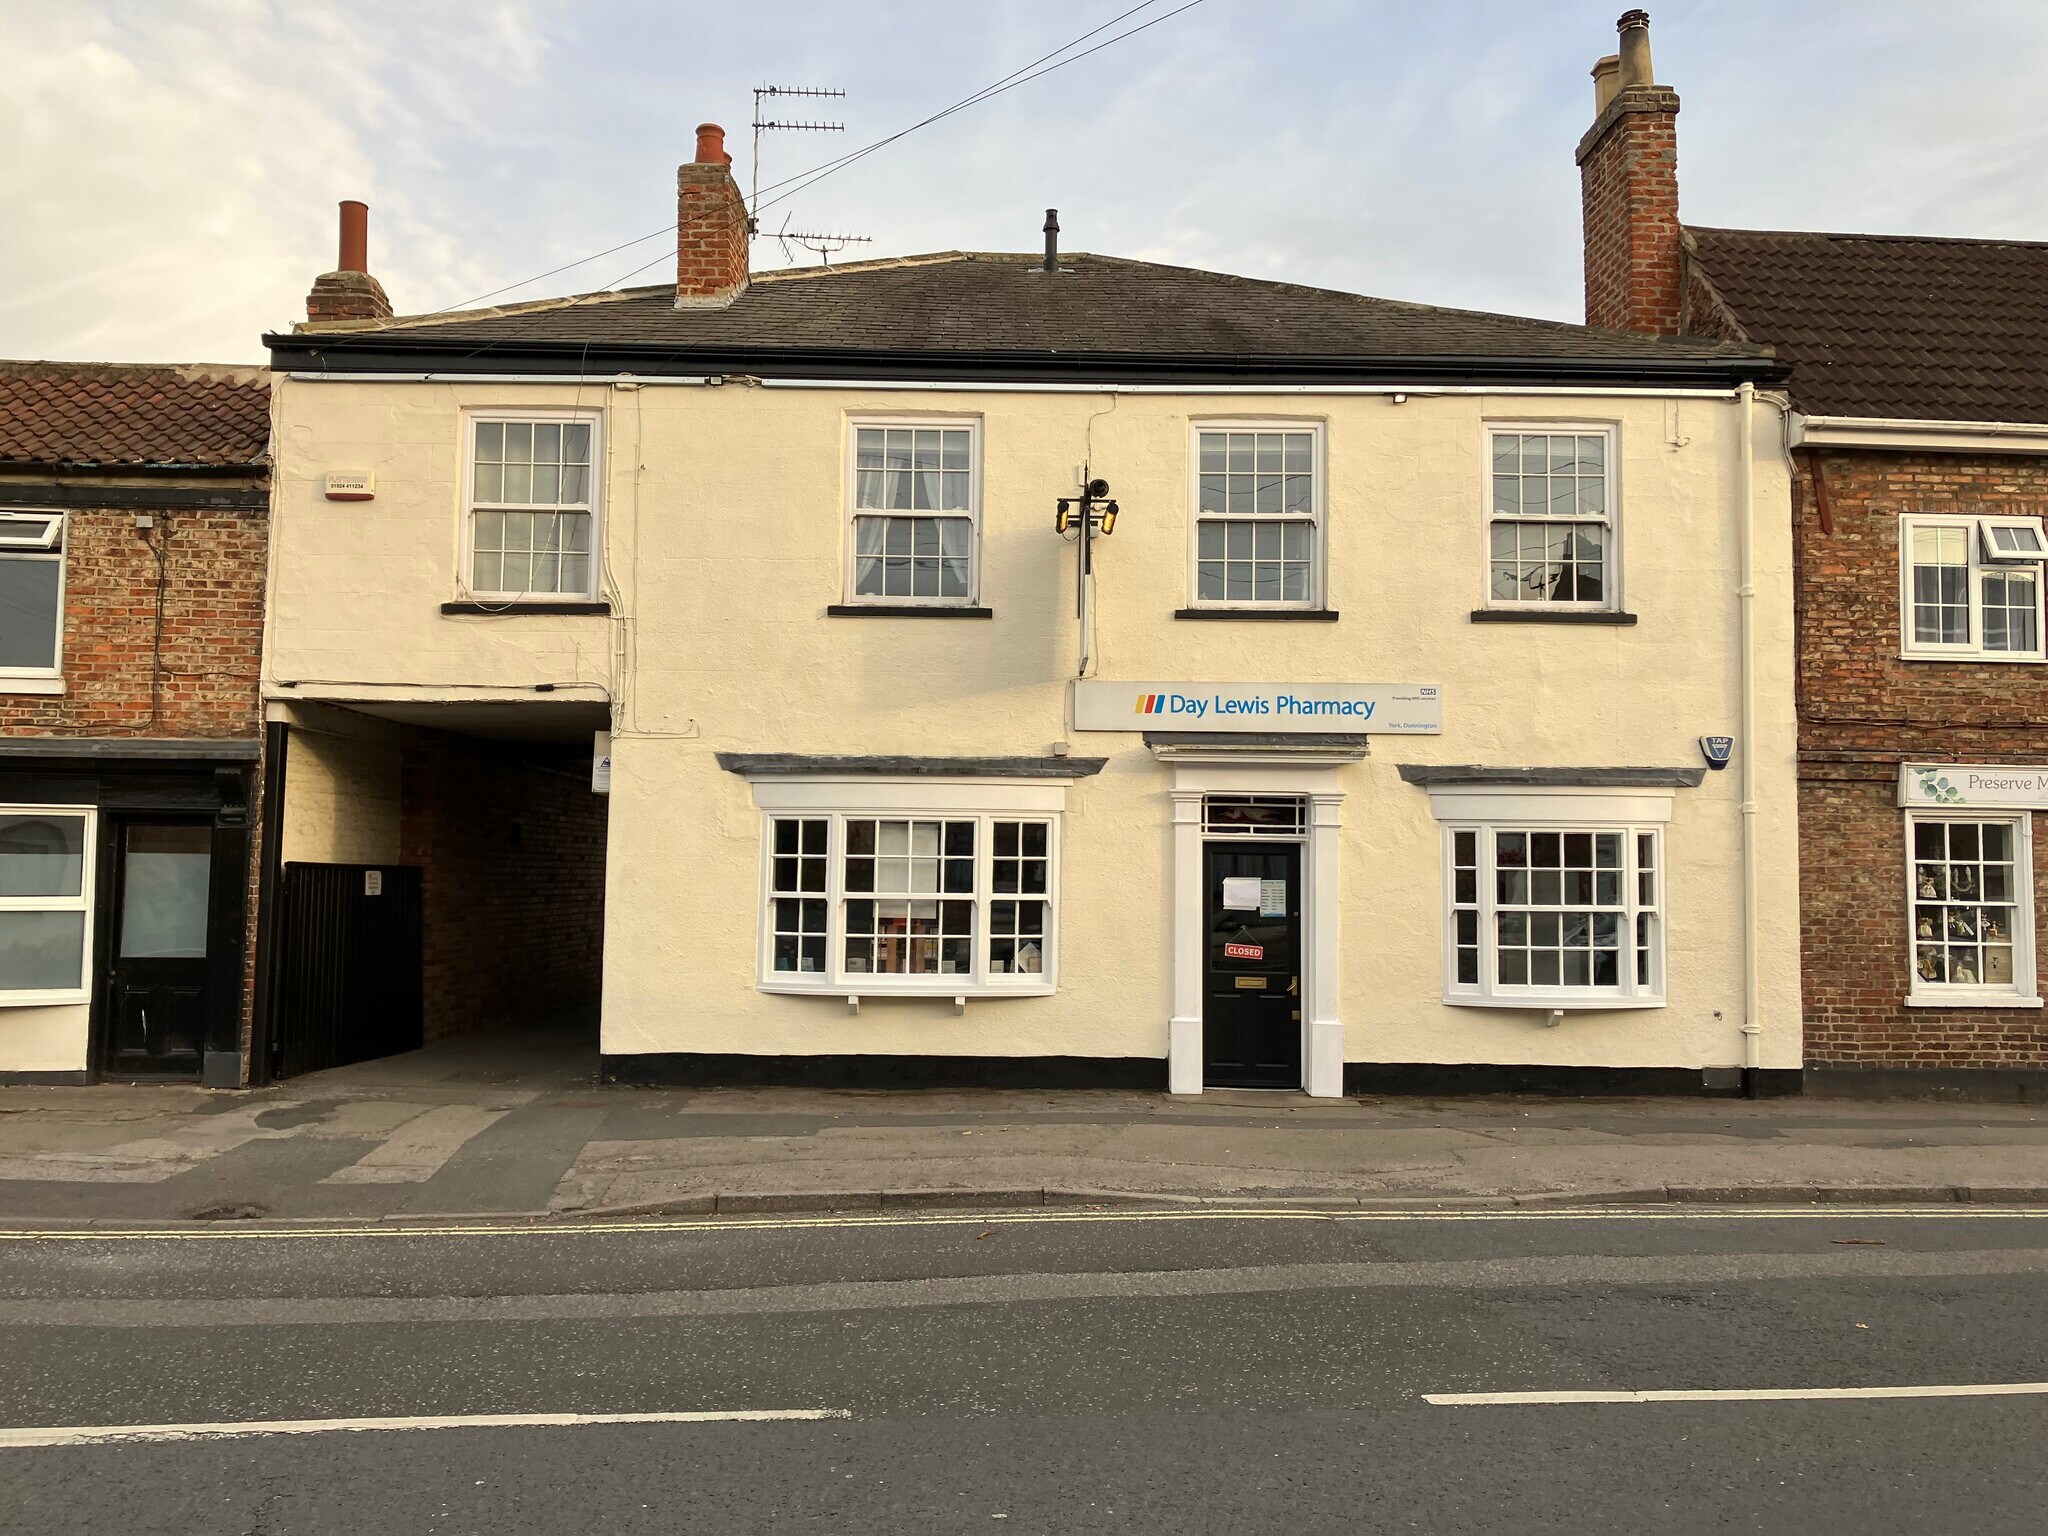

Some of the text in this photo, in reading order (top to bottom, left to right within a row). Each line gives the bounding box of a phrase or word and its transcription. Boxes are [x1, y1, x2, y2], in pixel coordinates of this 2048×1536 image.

[1170, 694, 1376, 720] Day Lewis Pharmacy
[1969, 774, 2032, 790] Preserve
[1228, 946, 1260, 957] CLOSED
